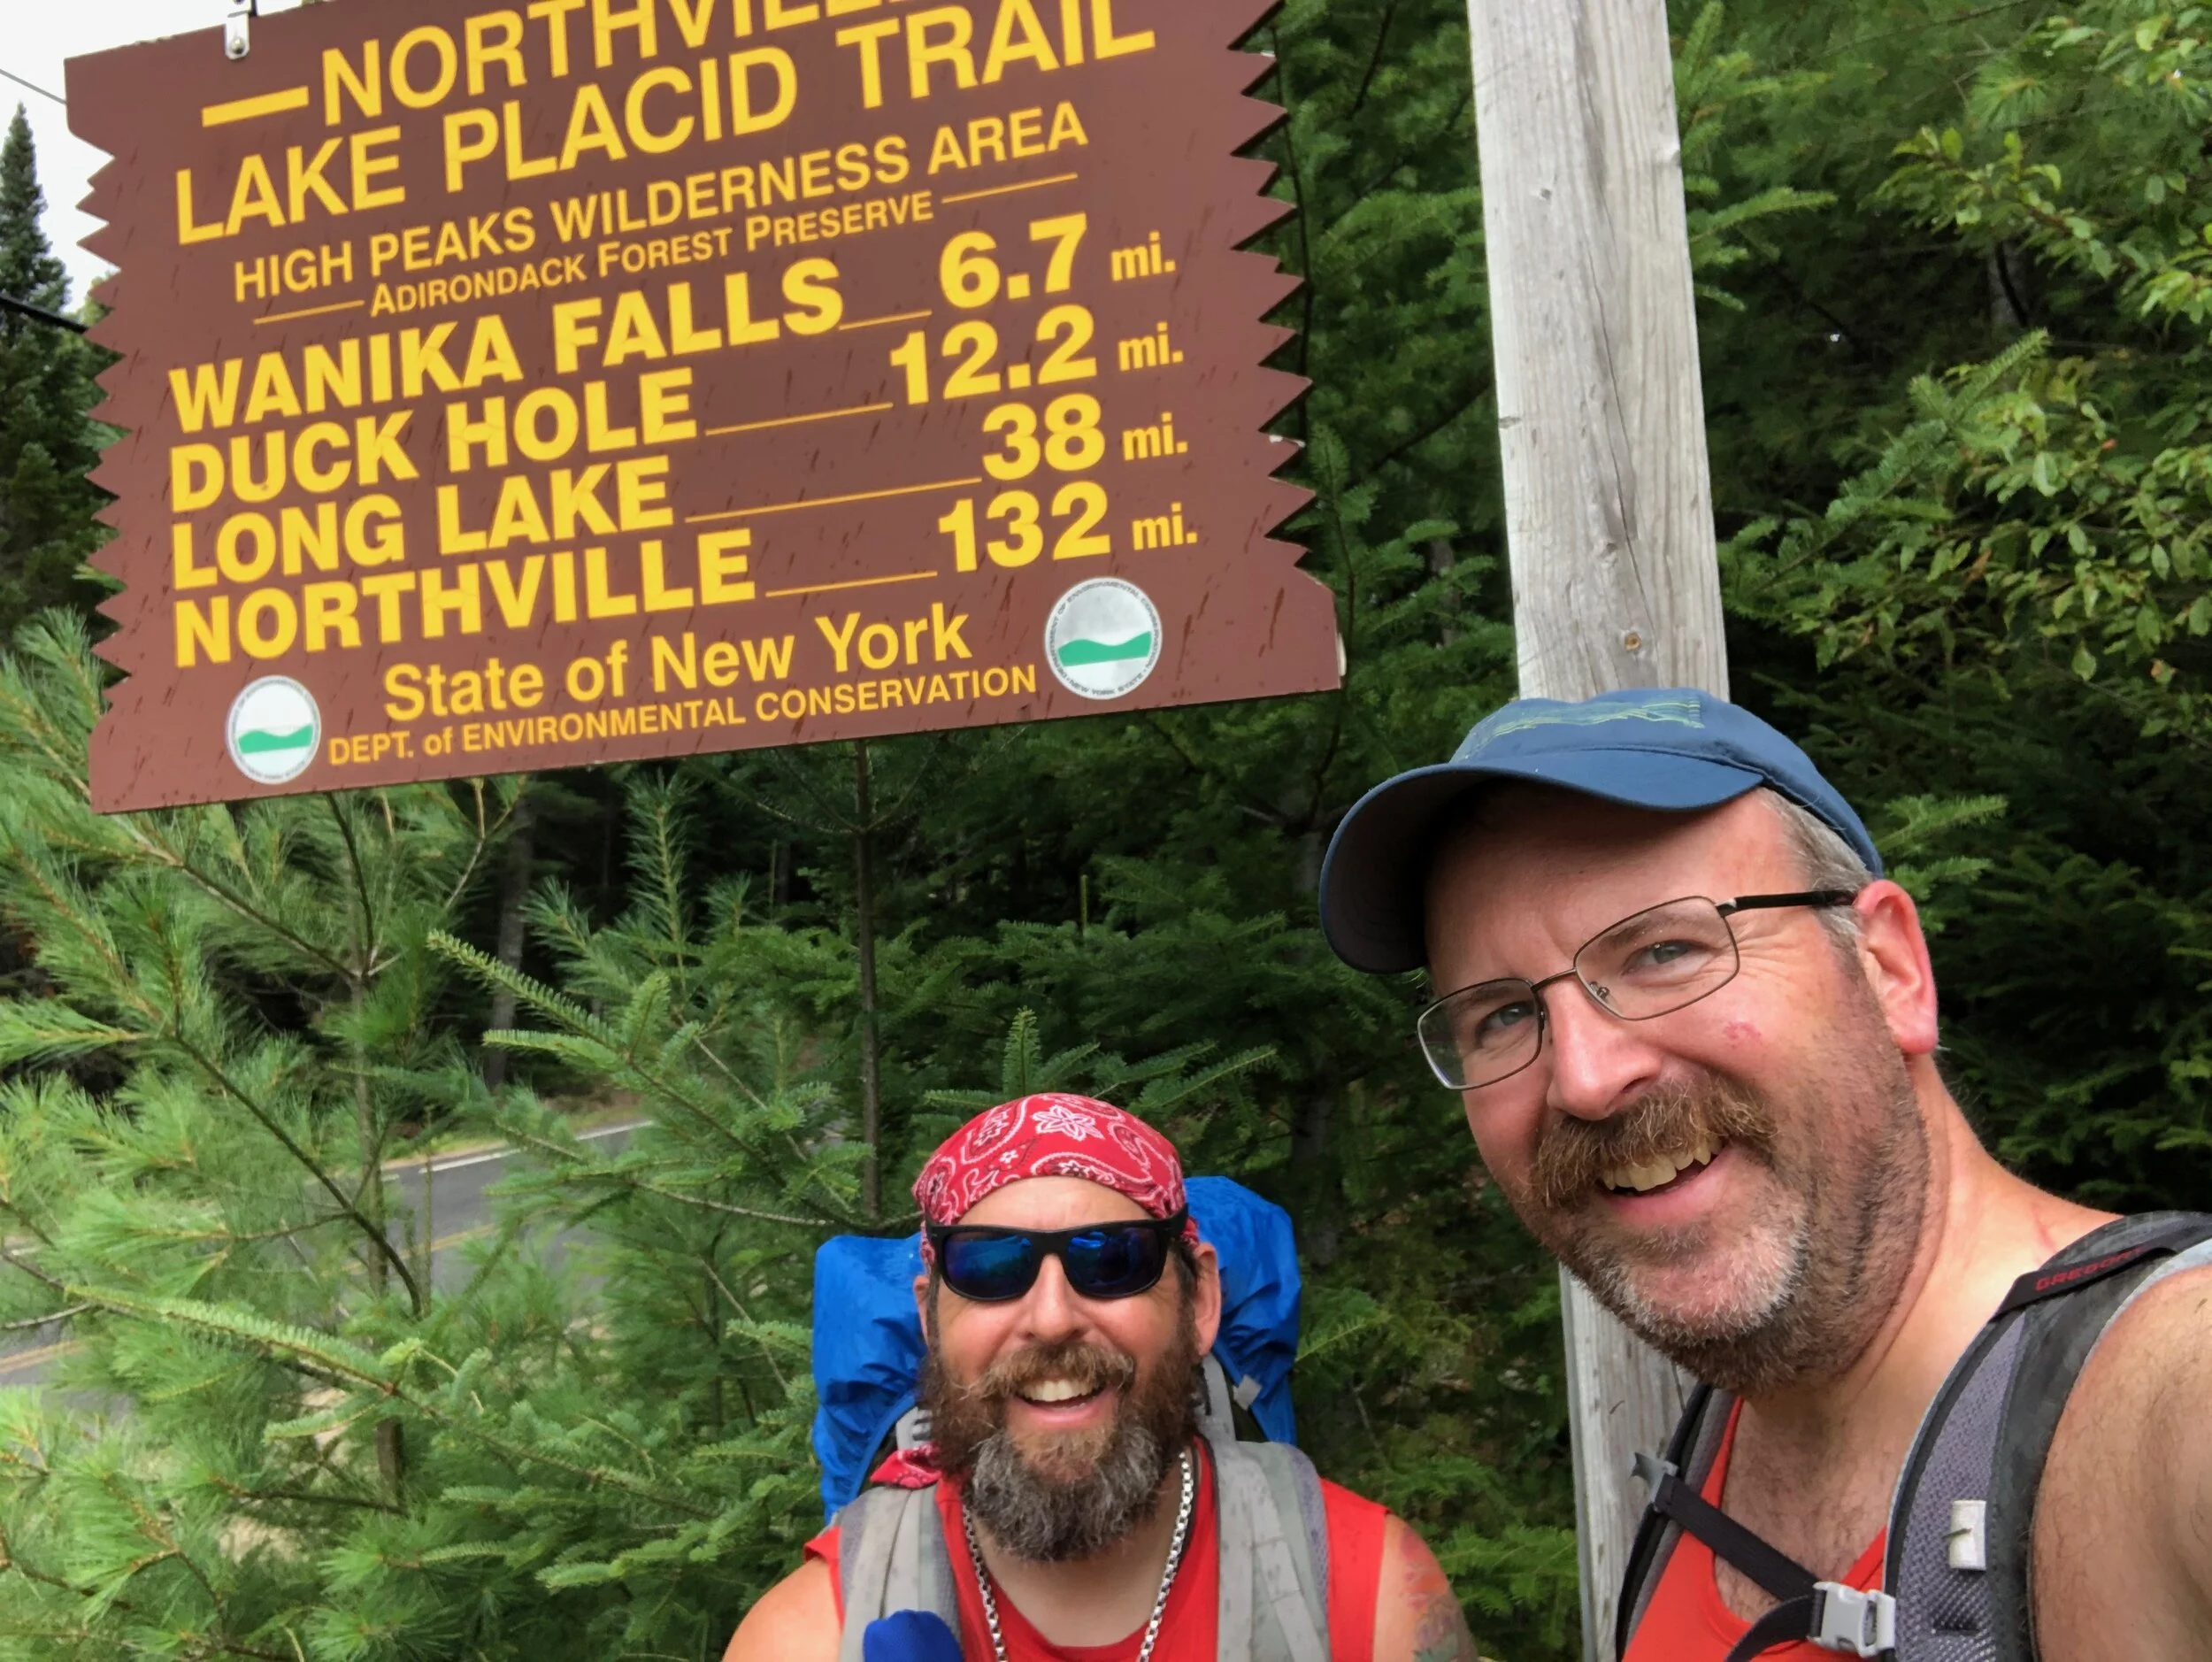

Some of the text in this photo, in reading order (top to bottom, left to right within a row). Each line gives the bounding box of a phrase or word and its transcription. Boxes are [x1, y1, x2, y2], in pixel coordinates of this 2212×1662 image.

[177, 0, 1156, 244] LAKE PLACID TRAIL
[323, 0, 899, 126] NORTHVIL
[234, 101, 1089, 303] HIGH PEAKS WILDERNESS AREA
[370, 191, 933, 318] ADIRONDACK FOREST PRESERVE
[168, 212, 1176, 434] WANIKA FALLS 6.7 mi.
[170, 304, 1184, 513] DUCK HOLE 12.2 mi.
[172, 393, 1188, 591] LONG LAKE 38 mi.
[174, 481, 1198, 669] NORTHVILLE 132 mi.
[327, 729, 414, 766] DEPT.
[423, 726, 454, 756] of
[461, 696, 747, 753] ENVIRONMENTAL
[756, 664, 1037, 721] CONSERVATION
[382, 602, 973, 723] State of New York
